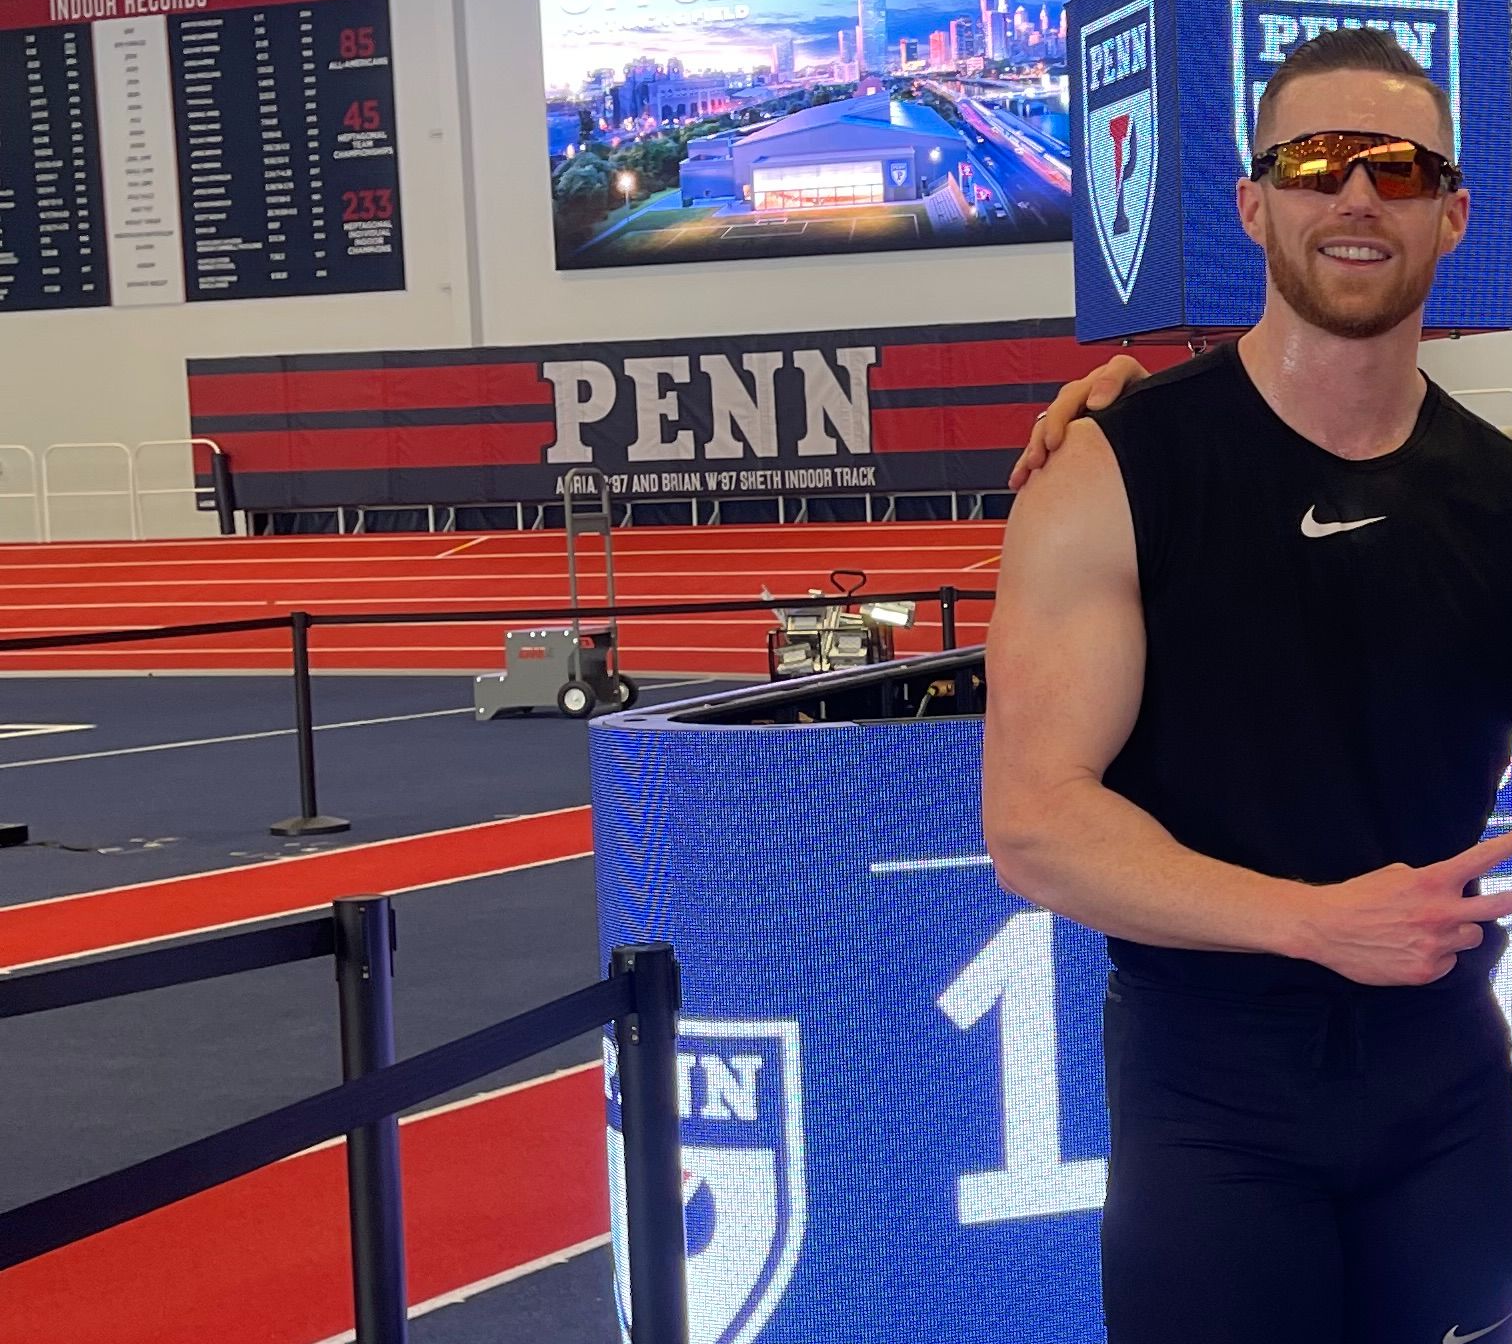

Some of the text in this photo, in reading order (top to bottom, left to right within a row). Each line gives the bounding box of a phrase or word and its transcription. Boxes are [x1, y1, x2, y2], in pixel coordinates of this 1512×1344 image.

[339, 27, 376, 58] 85
[1088, 22, 1148, 92] PENN
[342, 100, 381, 130] 45
[342, 188, 394, 222] 233
[543, 348, 878, 464] PENN
[632, 473, 659, 493] AND
[705, 470, 737, 491] W'97
[740, 469, 782, 491] SHETH
[785, 468, 833, 489] INDOOR
[834, 466, 876, 487] TRACK
